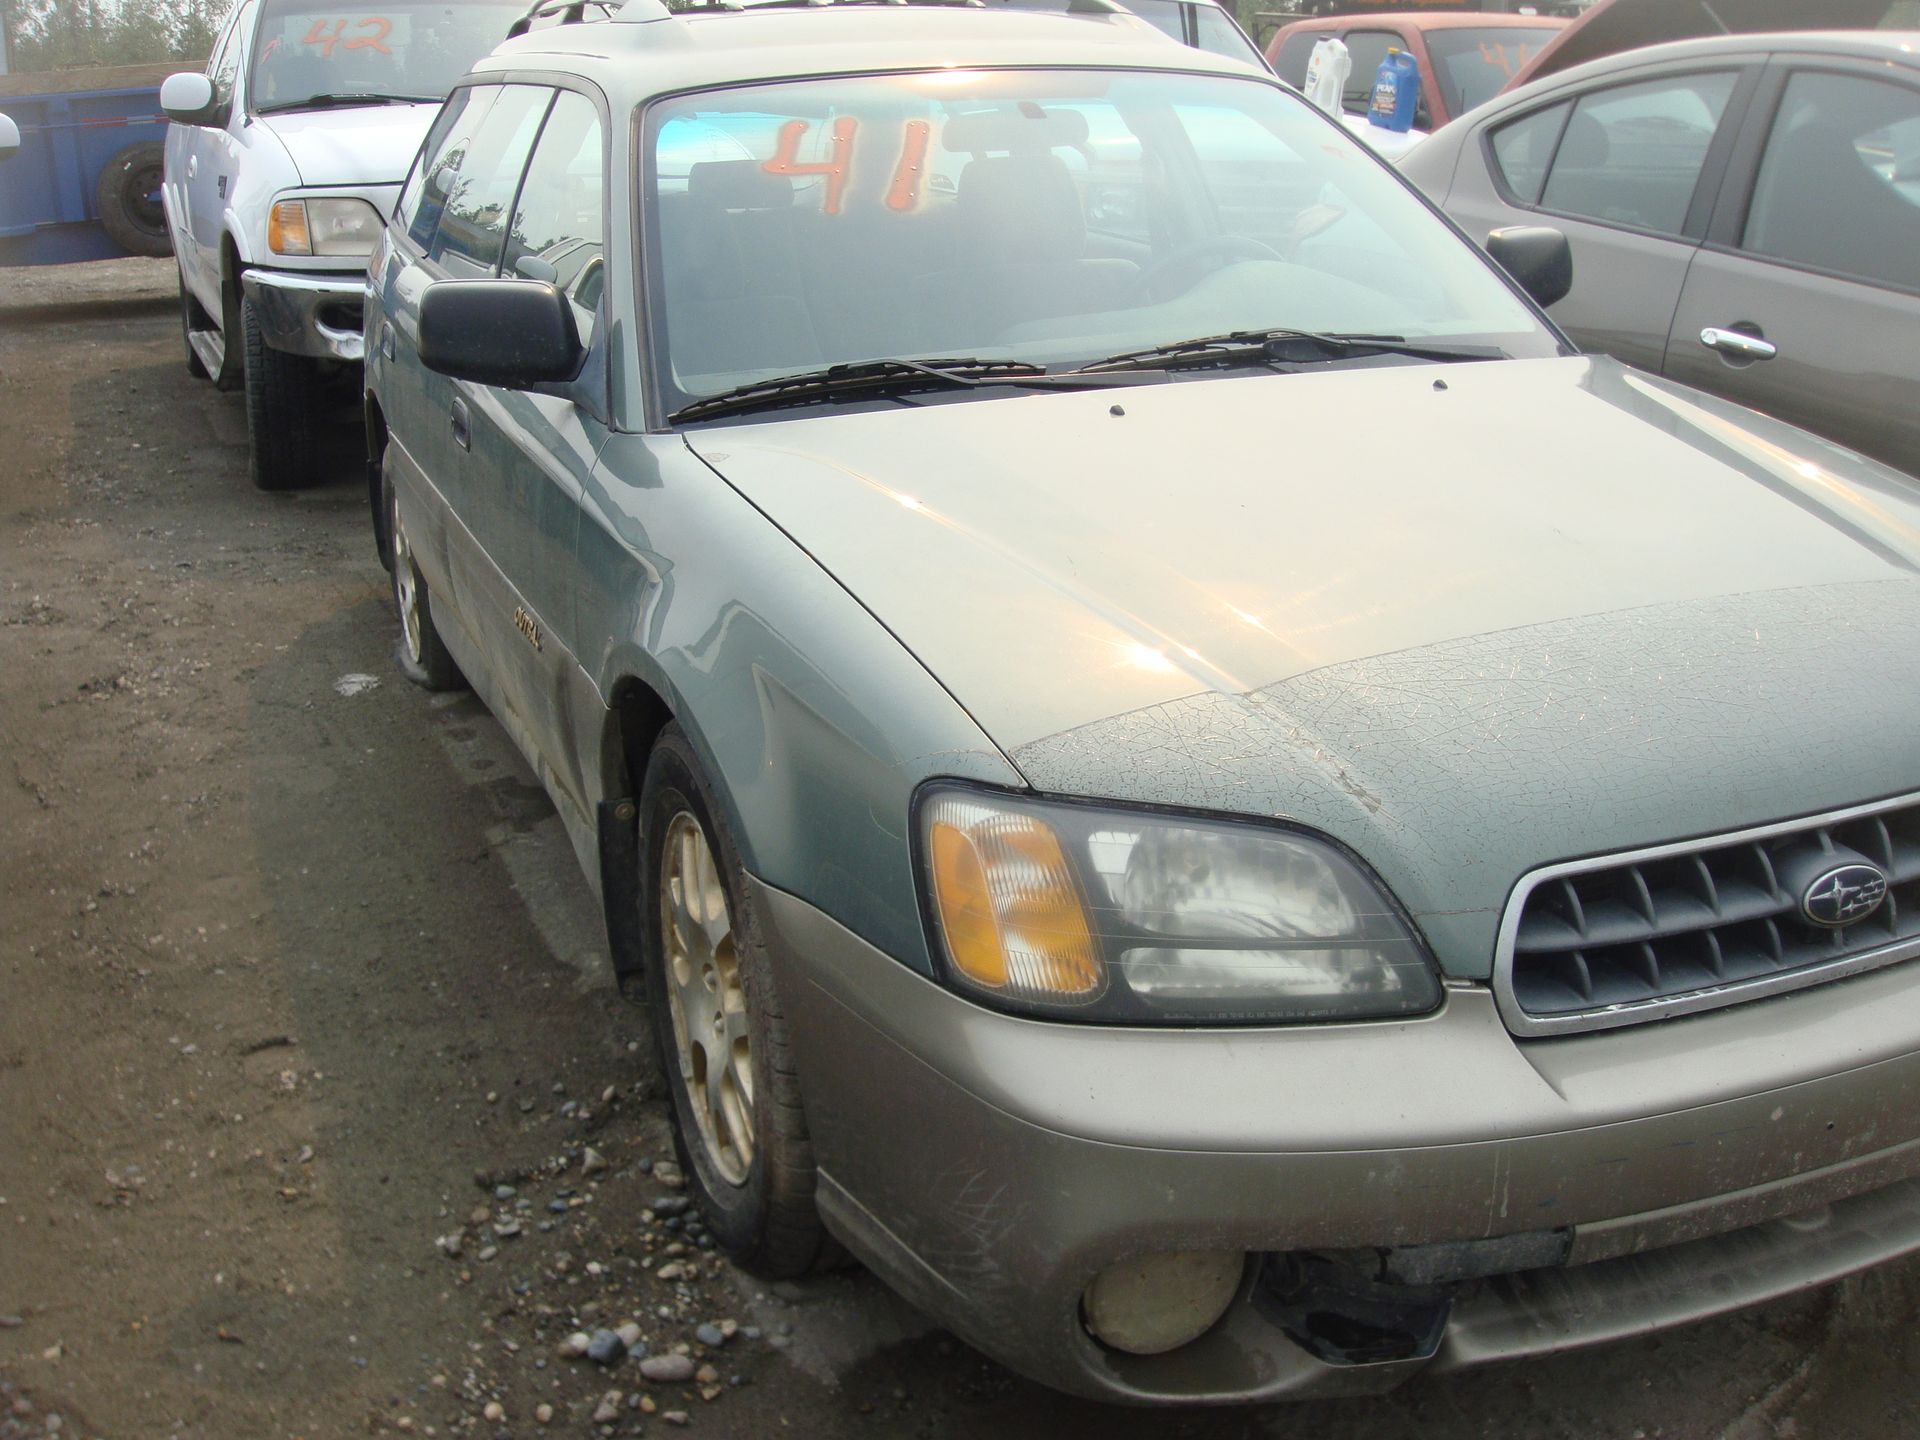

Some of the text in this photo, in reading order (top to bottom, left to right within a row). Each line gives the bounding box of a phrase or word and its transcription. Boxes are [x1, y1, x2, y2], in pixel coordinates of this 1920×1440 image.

[303, 16, 393, 58] 42
[1376, 84, 1397, 95] PEAK
[761, 116, 930, 215] 41
